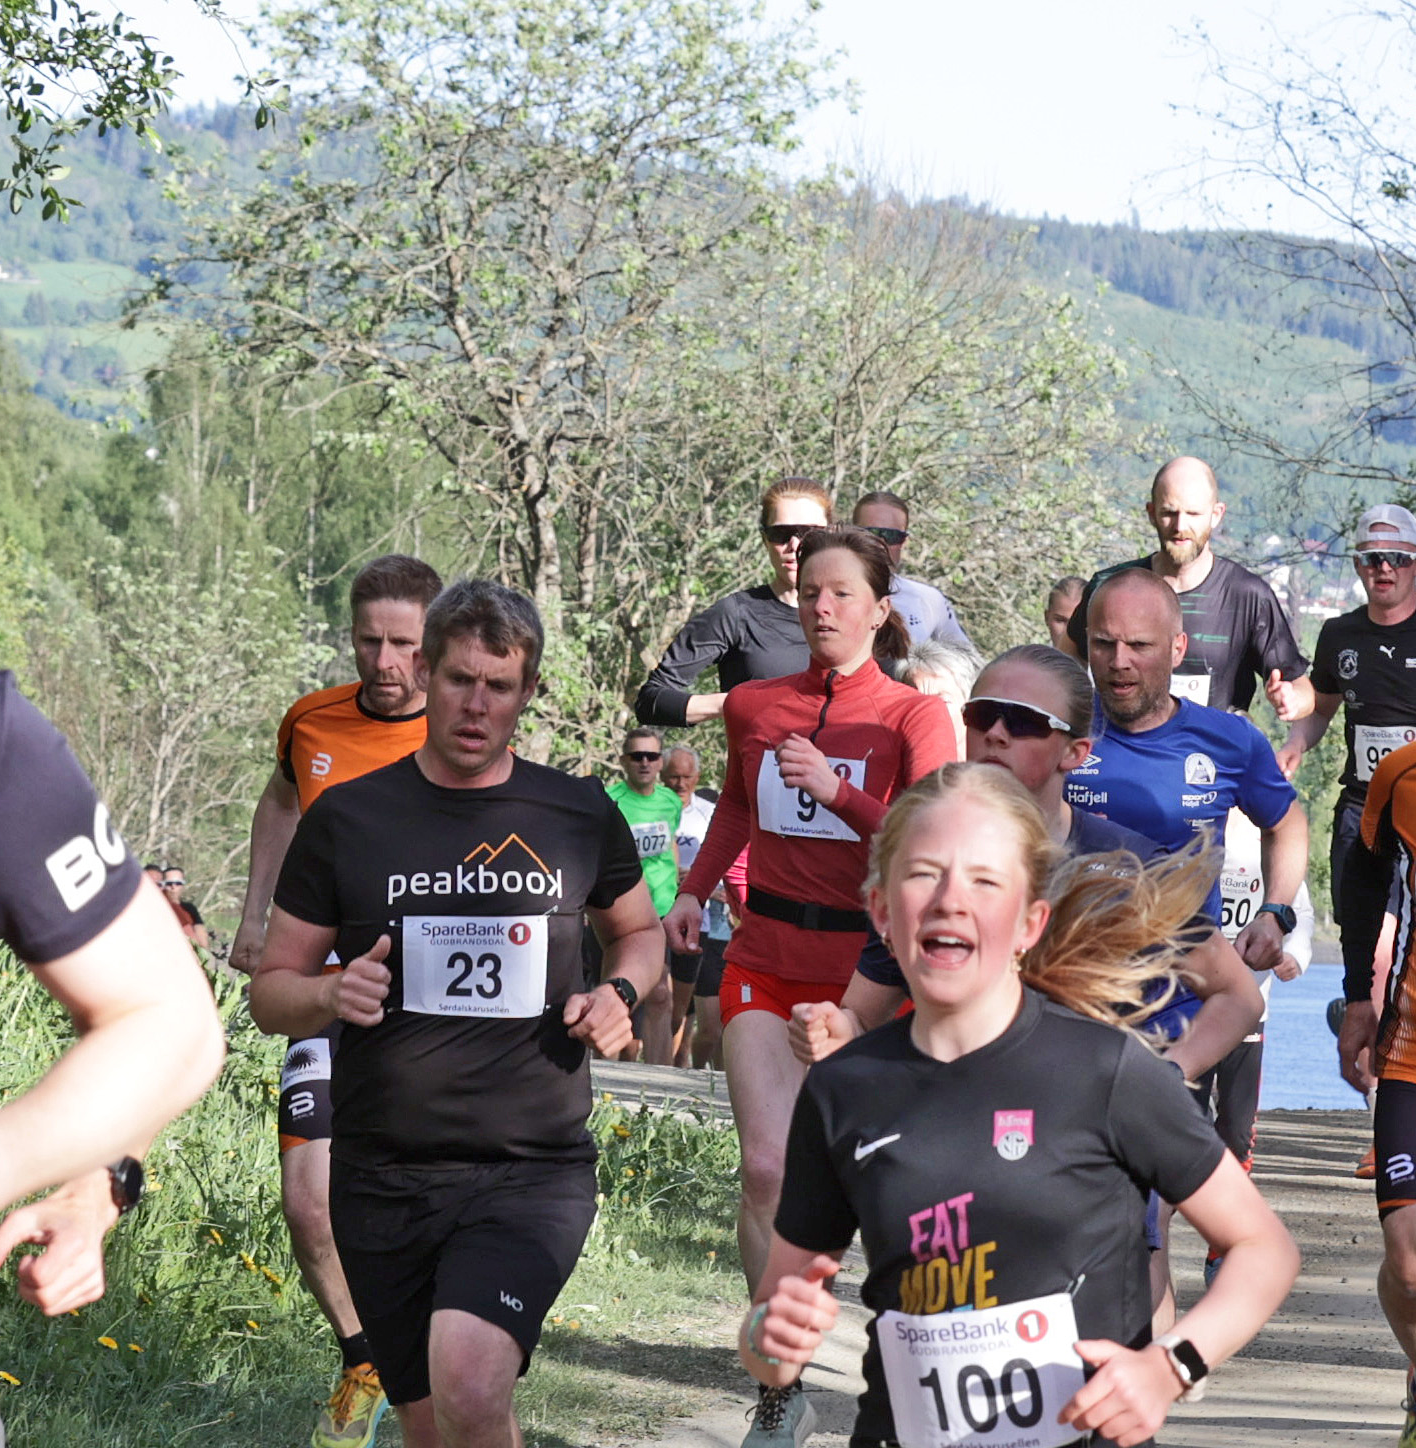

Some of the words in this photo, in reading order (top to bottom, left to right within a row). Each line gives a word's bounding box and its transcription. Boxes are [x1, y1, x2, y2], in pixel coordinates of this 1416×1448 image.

[1067, 791, 1108, 806] Hafjell
[387, 864, 563, 905] peakbook
[421, 922, 505, 938] SpareBank
[430, 938, 505, 946] GUDBRANDSDAL
[446, 951, 503, 999] 23
[438, 1003, 510, 1014] Sørdalskarusellen
[908, 1191, 975, 1264] EAT
[899, 1240, 998, 1316] MOVE
[895, 1317, 1010, 1345] SpareBank
[908, 1339, 1012, 1357] GUDBRANDSDAL
[919, 1357, 1043, 1434] 100
